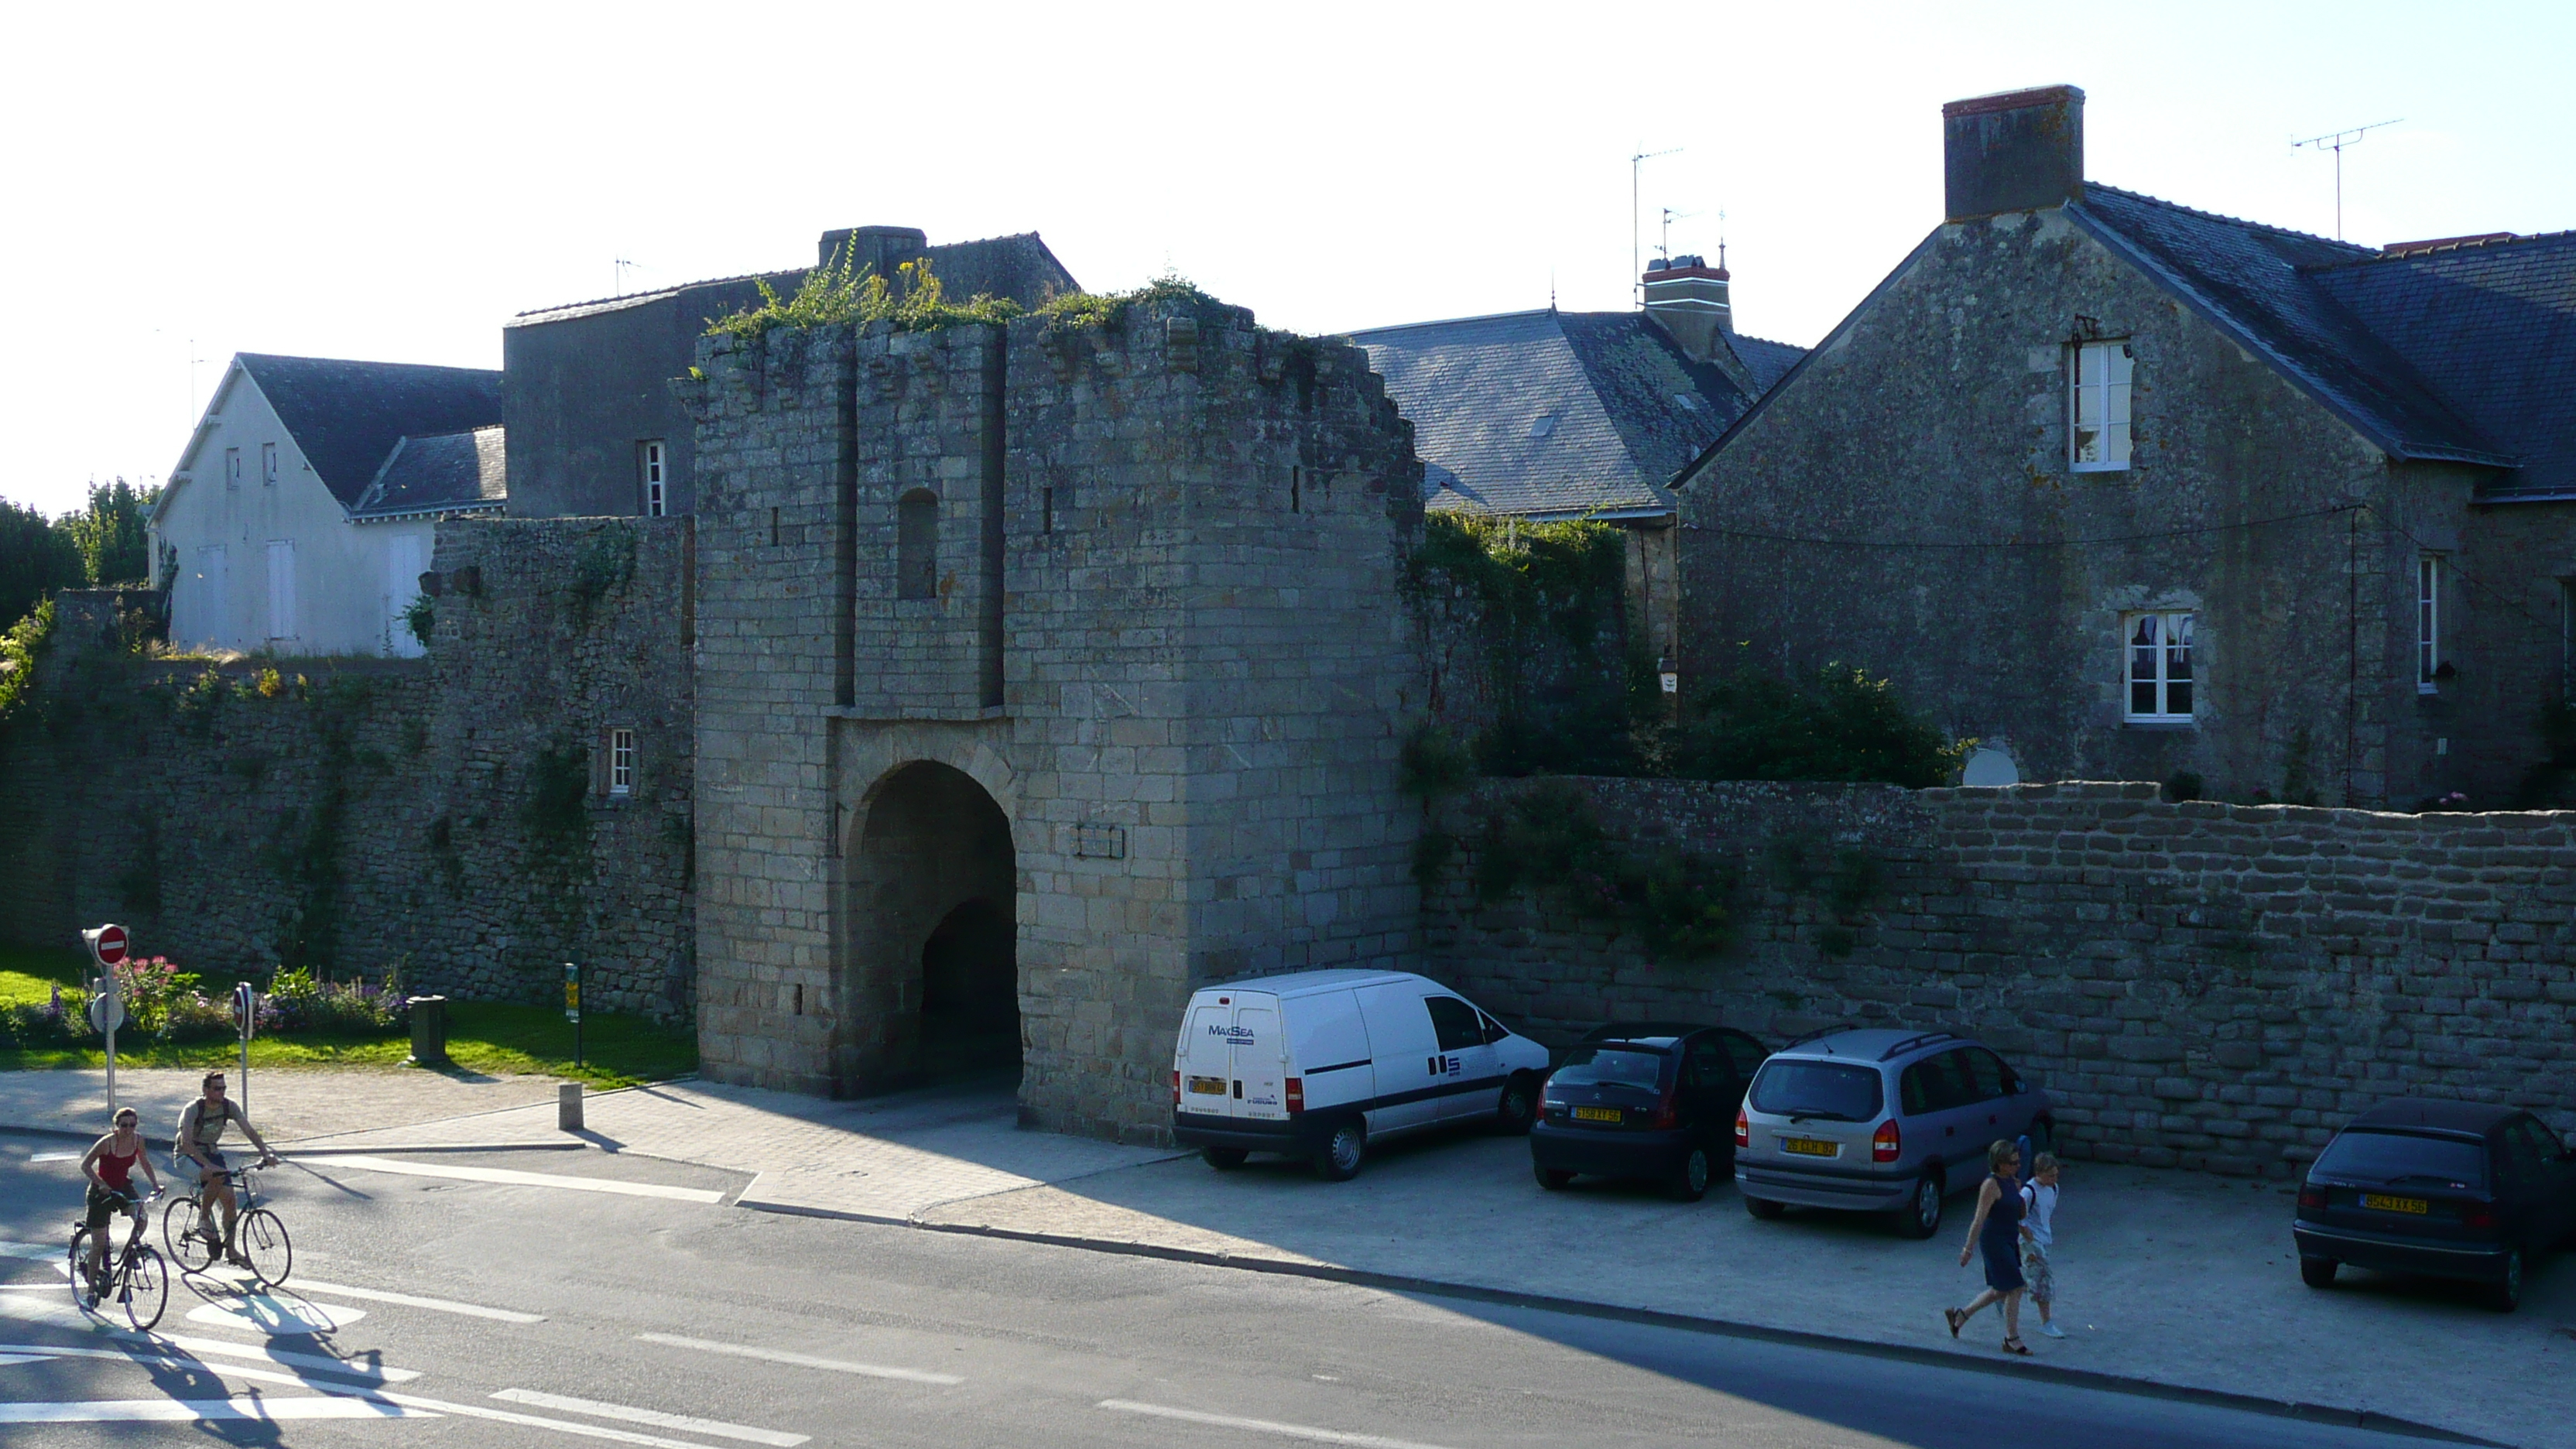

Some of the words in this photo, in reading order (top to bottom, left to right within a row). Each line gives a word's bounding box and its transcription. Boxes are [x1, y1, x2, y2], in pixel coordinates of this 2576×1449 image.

[1608, 1110, 1619, 1121] 56
[2395, 1197, 2409, 1210] XX
[2411, 1200, 2425, 1212] 56
